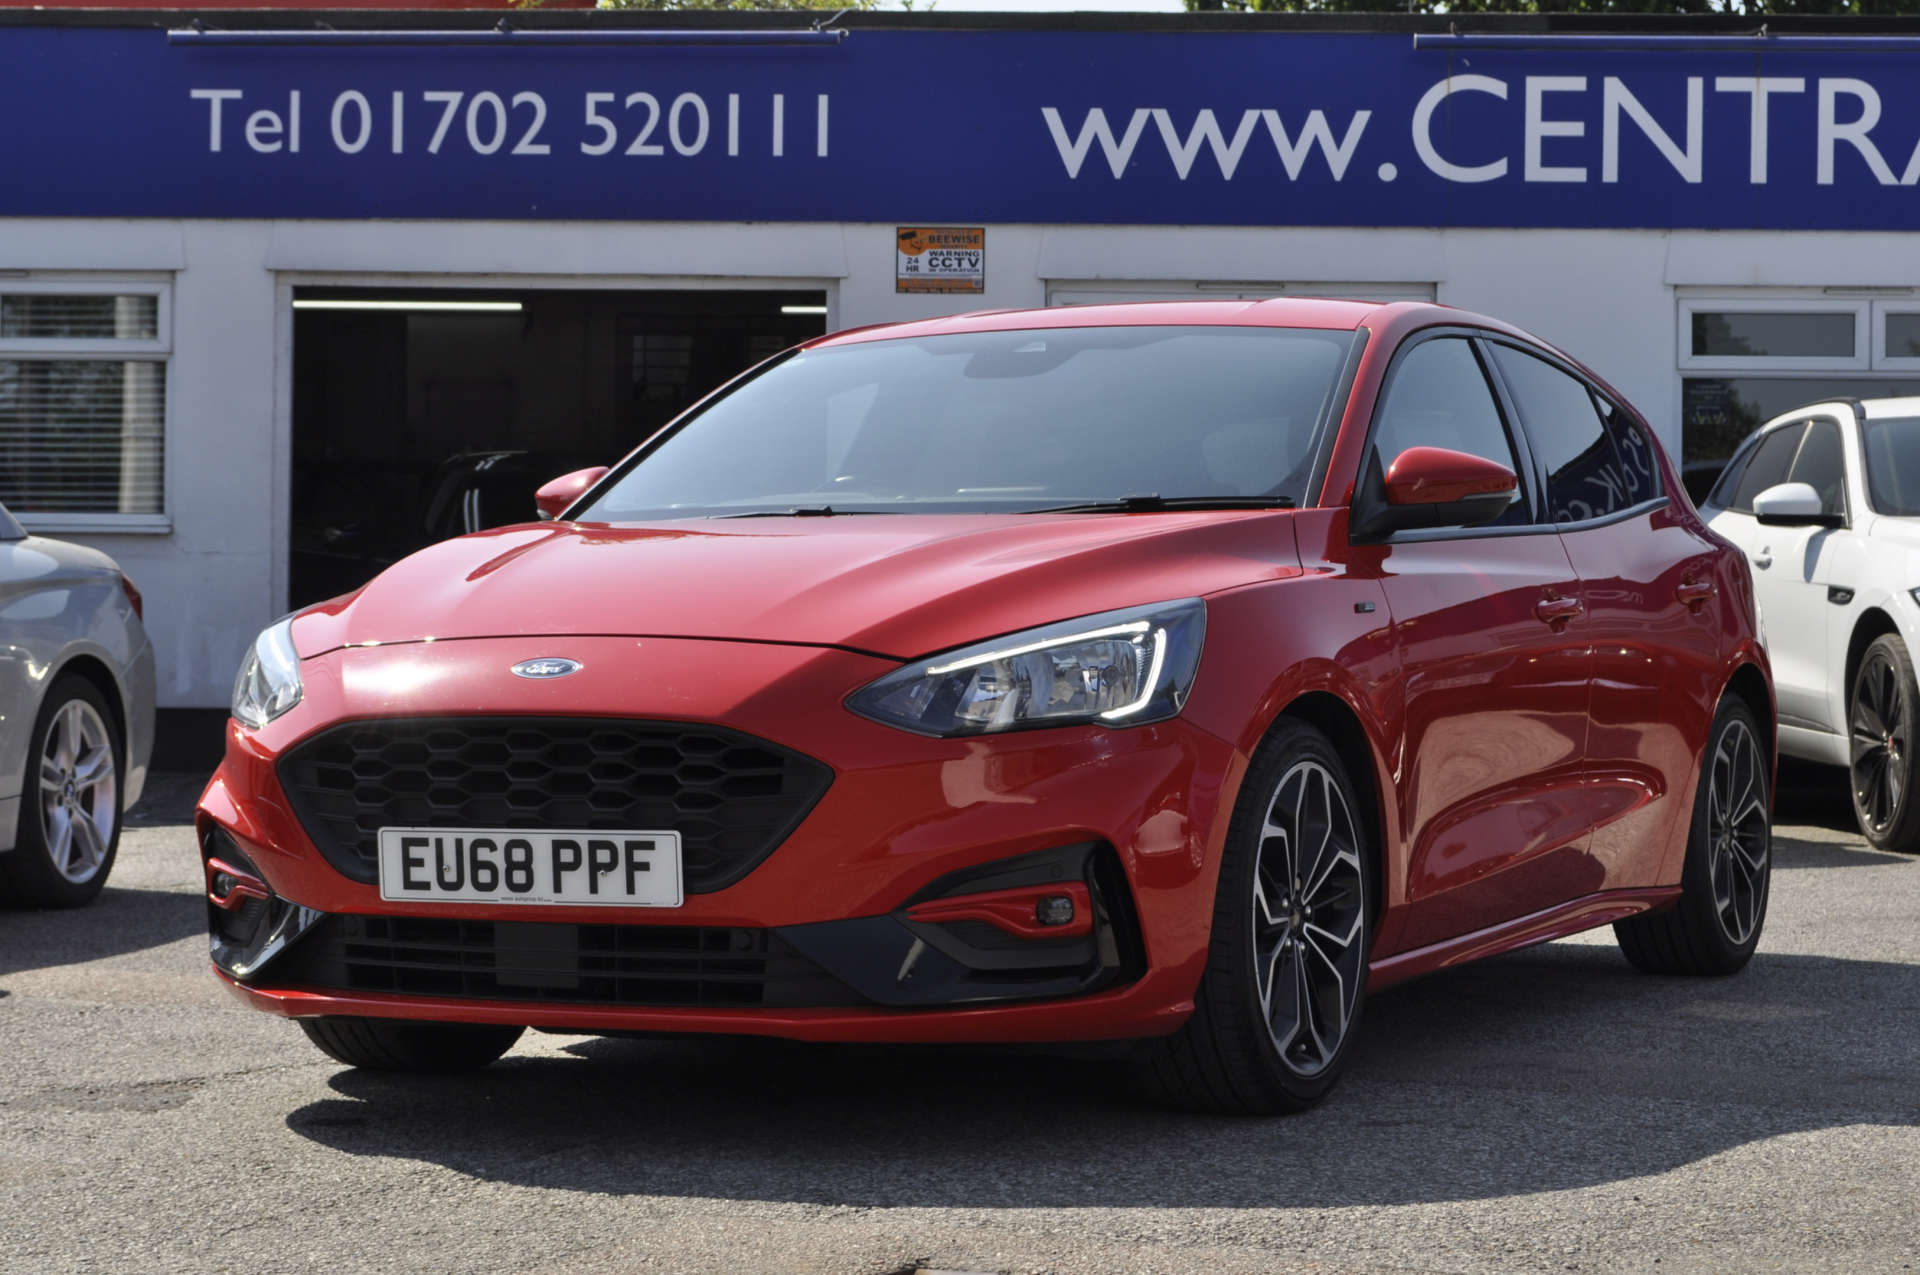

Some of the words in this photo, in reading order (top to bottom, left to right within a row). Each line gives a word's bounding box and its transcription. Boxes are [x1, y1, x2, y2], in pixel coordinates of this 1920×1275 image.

[191, 90, 299, 152] Tel
[332, 90, 550, 154] 01702
[581, 93, 828, 156] 520111
[1042, 75, 1920, 185] www.CENTR
[905, 265, 919, 273] HR
[928, 257, 979, 268] CCTV
[402, 838, 534, 892] EU68
[552, 840, 655, 894] PPF
